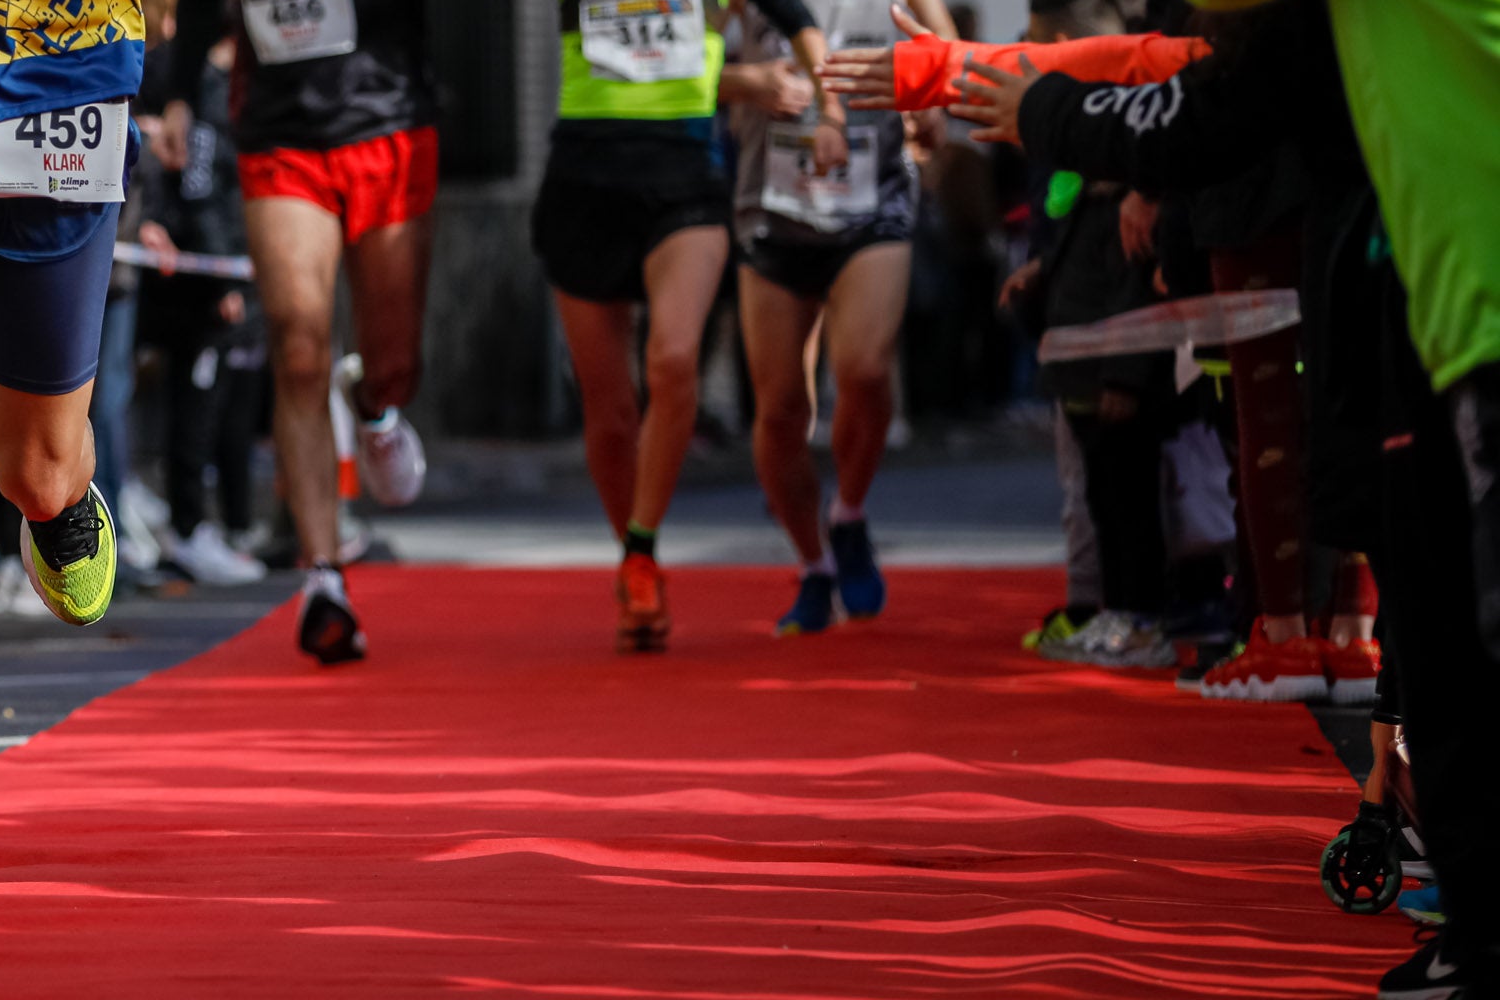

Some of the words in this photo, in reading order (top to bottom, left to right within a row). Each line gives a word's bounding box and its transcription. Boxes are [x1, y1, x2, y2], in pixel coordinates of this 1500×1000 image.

[15, 106, 103, 150] 459
[43, 153, 86, 172] KLARK
[61, 177, 90, 188] olimpo
